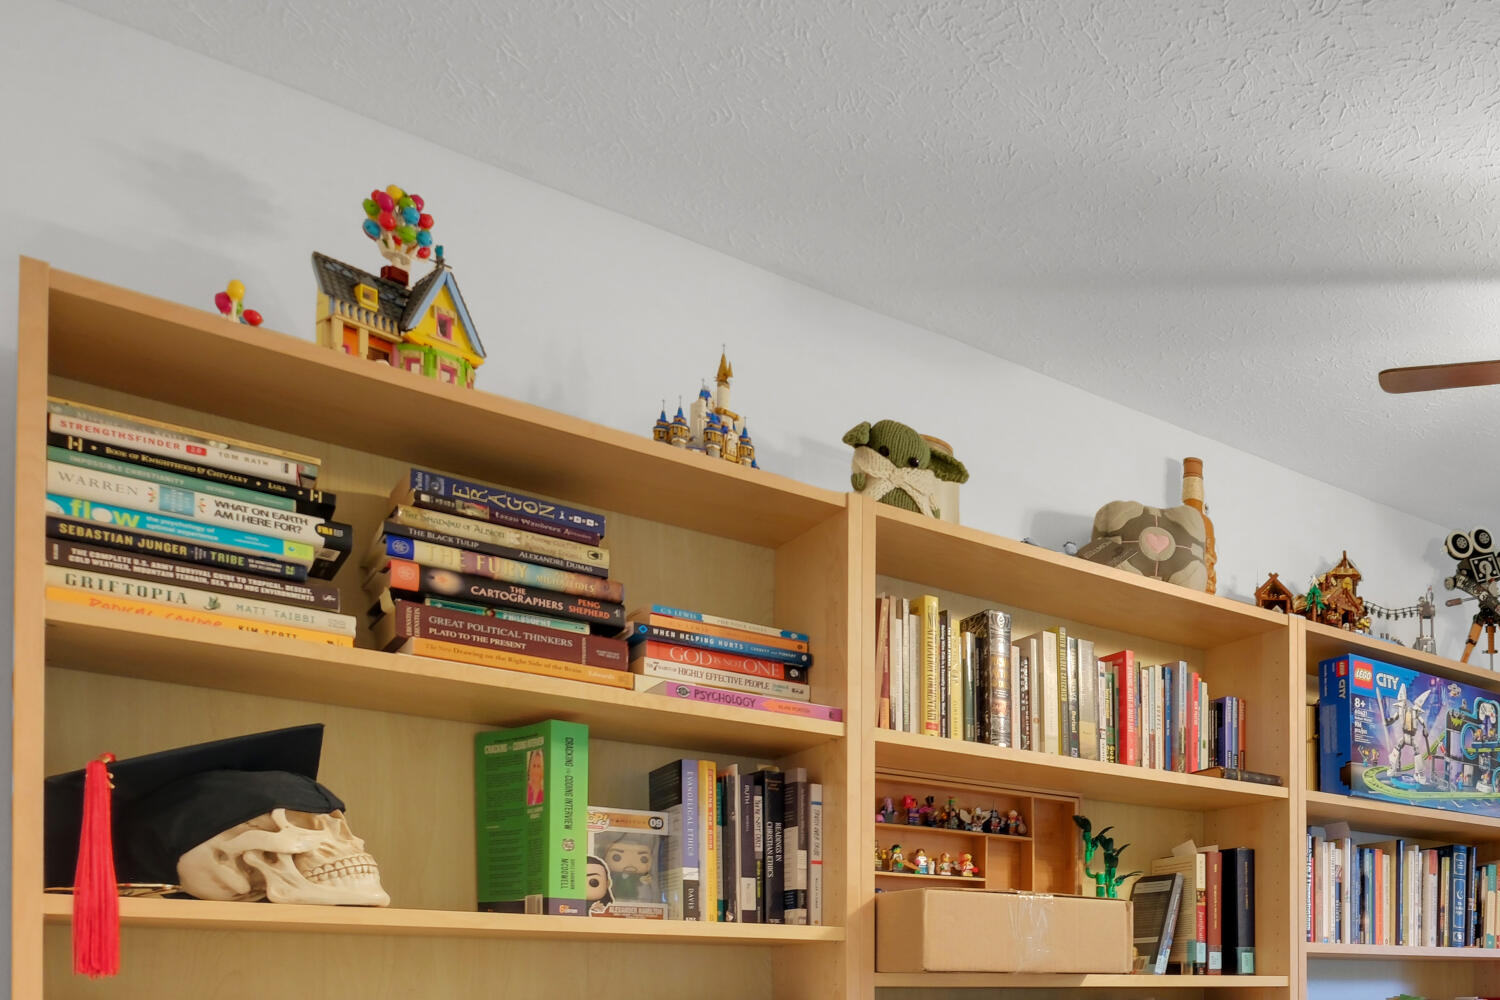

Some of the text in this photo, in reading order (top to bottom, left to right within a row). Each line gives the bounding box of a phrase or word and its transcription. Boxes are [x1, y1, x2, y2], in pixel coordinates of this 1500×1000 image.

[58, 471, 138, 496] WARREN
[452, 484, 556, 519] ERAGON
[214, 499, 308, 526] WHAT ON EARTH
[58, 522, 187, 556] SEBASTIAN JUNGER
[408, 528, 479, 548] THE BLACK TULIP
[210, 551, 245, 567] TRIBE
[519, 551, 593, 572] ALEXANDRE DUMAS
[65, 572, 188, 605] GRIFTOPIA
[470, 585, 564, 611] CARTOGRAPHERS
[510, 586, 526, 596] THE
[236, 603, 314, 624] MATT TAIBBI
[569, 605, 610, 620] SHEPHERD
[578, 598, 600, 609] PENG
[428, 615, 573, 648] GREAT POLITICAL THINKERS
[428, 628, 526, 650] PLATO TO THE PRESENT
[652, 628, 744, 650] WHEN HELPING HURTS
[678, 666, 770, 690] HIGHLY EFFECTIVE PEOPLE
[1356, 668, 1372, 681] LEGO
[1376, 673, 1399, 690] CITY
[694, 688, 756, 708] PSYCHOLOGY
[1338, 679, 1346, 699] CITY
[1354, 698, 1366, 707] 8+
[687, 772, 695, 857] EVANGELICAL ETHICS
[776, 850, 782, 862] IN
[560, 858, 568, 889] MCDOWELL
